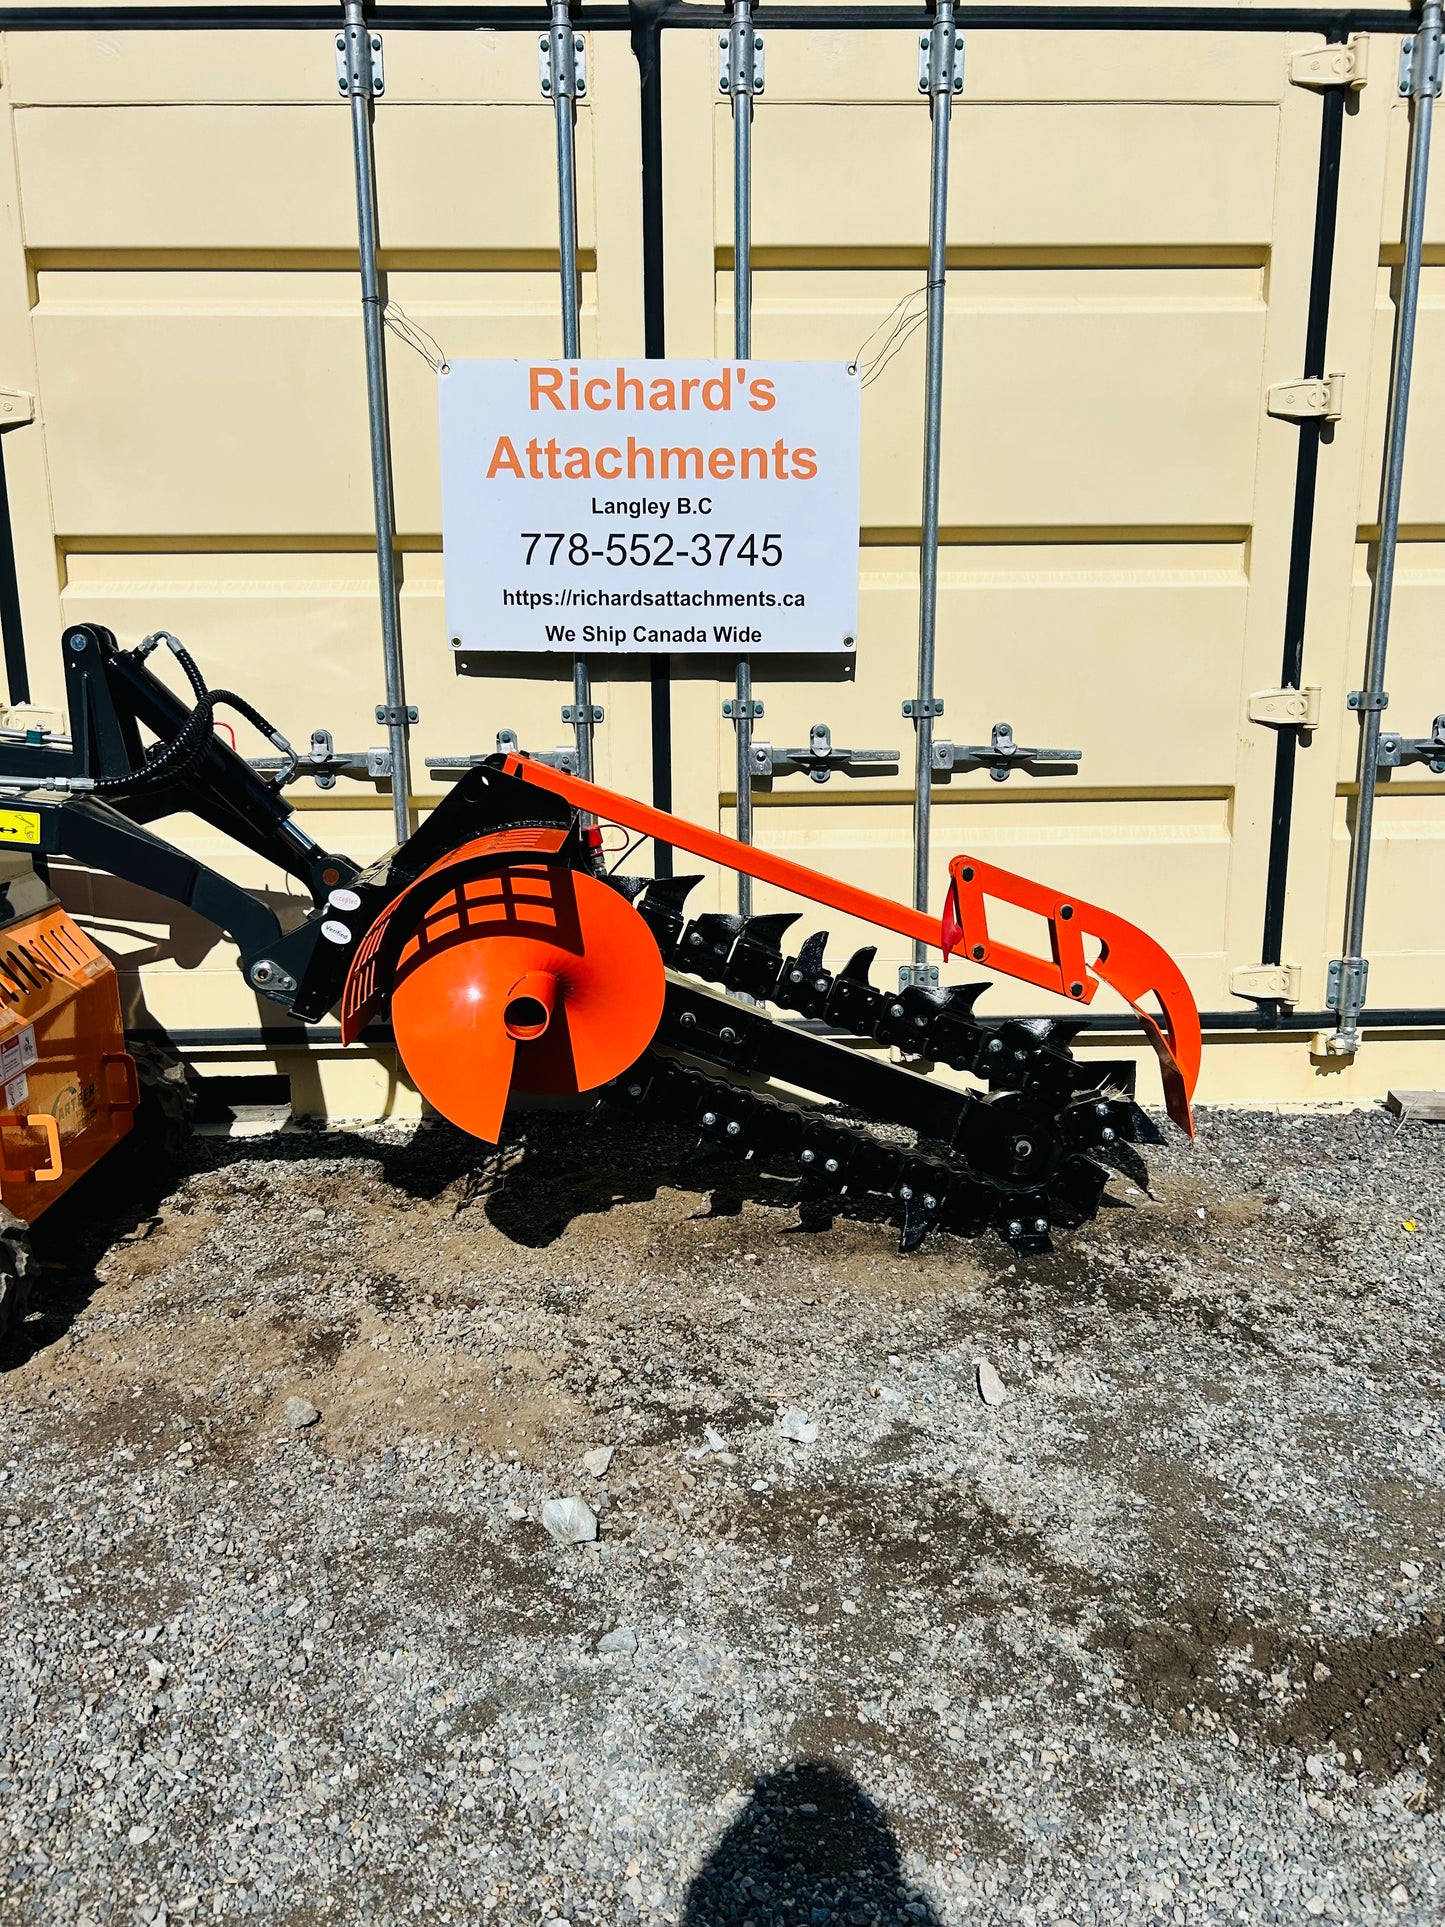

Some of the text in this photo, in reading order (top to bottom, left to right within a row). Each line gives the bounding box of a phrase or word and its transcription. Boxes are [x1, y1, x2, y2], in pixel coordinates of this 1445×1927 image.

[530, 367, 776, 411] Richard's
[486, 436, 818, 480] Attachments
[592, 497, 713, 519] Langley B.C
[521, 533, 783, 567] 778-552-3745
[503, 589, 805, 609] https://richardsattachments.ca
[545, 625, 762, 647] We Ship Canada Wide
[326, 925, 348, 940] Verified
